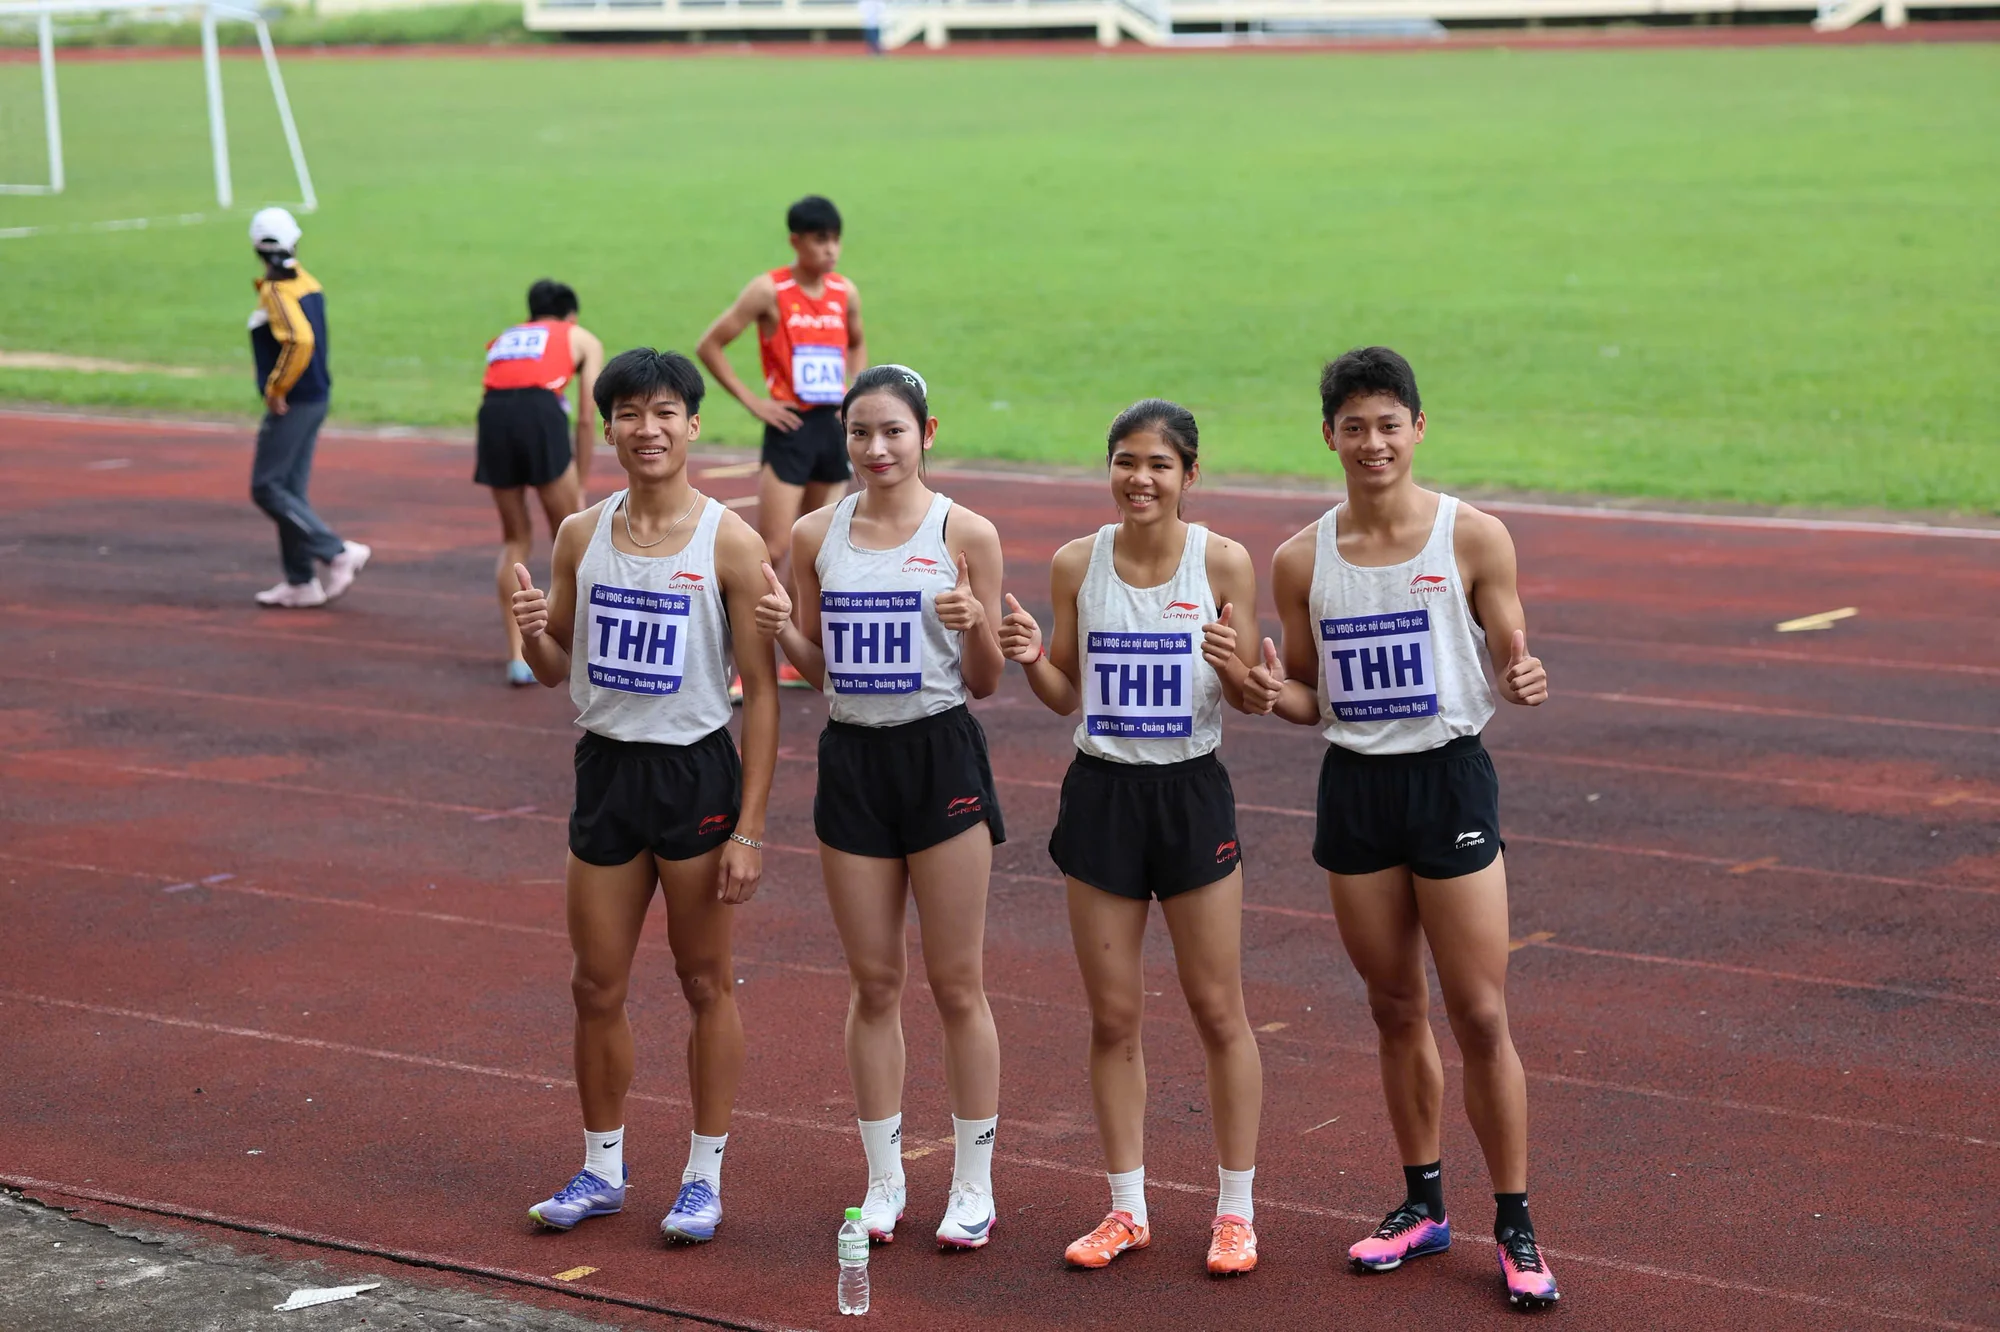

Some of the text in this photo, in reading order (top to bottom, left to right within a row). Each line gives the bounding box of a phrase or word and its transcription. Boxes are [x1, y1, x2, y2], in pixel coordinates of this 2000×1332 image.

[1410, 586, 1447, 594] LI-NING
[606, 592, 622, 602] VĐQG
[624, 595, 635, 604] các
[636, 596, 645, 607] nội
[646, 597, 657, 608] dung
[659, 598, 672, 610] Tiếp
[674, 600, 684, 609] sức
[834, 597, 850, 606] VĐQG
[851, 598, 862, 606] các
[864, 597, 873, 608] nội
[875, 598, 890, 608] dung
[891, 596, 904, 608] Tiếp
[905, 596, 916, 606] sức
[1336, 624, 1353, 634] VĐQG
[1356, 622, 1367, 632] các
[1369, 621, 1378, 632] nội
[1380, 620, 1395, 630] dung
[1396, 616, 1410, 629] Tiếp
[1412, 616, 1423, 626] sức
[596, 615, 677, 666] THH
[828, 622, 911, 664] THH
[1103, 638, 1120, 648] VĐQG
[1121, 638, 1130, 648] các
[1132, 639, 1141, 650] nội
[1143, 639, 1158, 650] dung
[1160, 638, 1174, 649] Tiếp
[1175, 638, 1186, 648] sức
[1332, 643, 1424, 692] THH
[593, 670, 602, 680] SVĐ
[604, 674, 615, 682] Kon
[617, 675, 629, 685] Tum
[635, 678, 655, 690] Quảng
[657, 680, 673, 691] Ngãi
[842, 679, 853, 688] Kon
[875, 679, 895, 689] Quảng
[898, 679, 912, 689] Ngãi
[1095, 663, 1181, 706] THH
[1340, 708, 1353, 716] SVĐ
[1354, 708, 1367, 716] Kon
[1368, 706, 1383, 715] Tum
[1390, 703, 1410, 714] Quảng
[1412, 701, 1428, 712] Ngãi
[1097, 721, 1109, 729] SVĐ
[1120, 723, 1134, 731] Tum
[1142, 722, 1164, 733] Quảng
[1167, 722, 1183, 733] Ngãi
